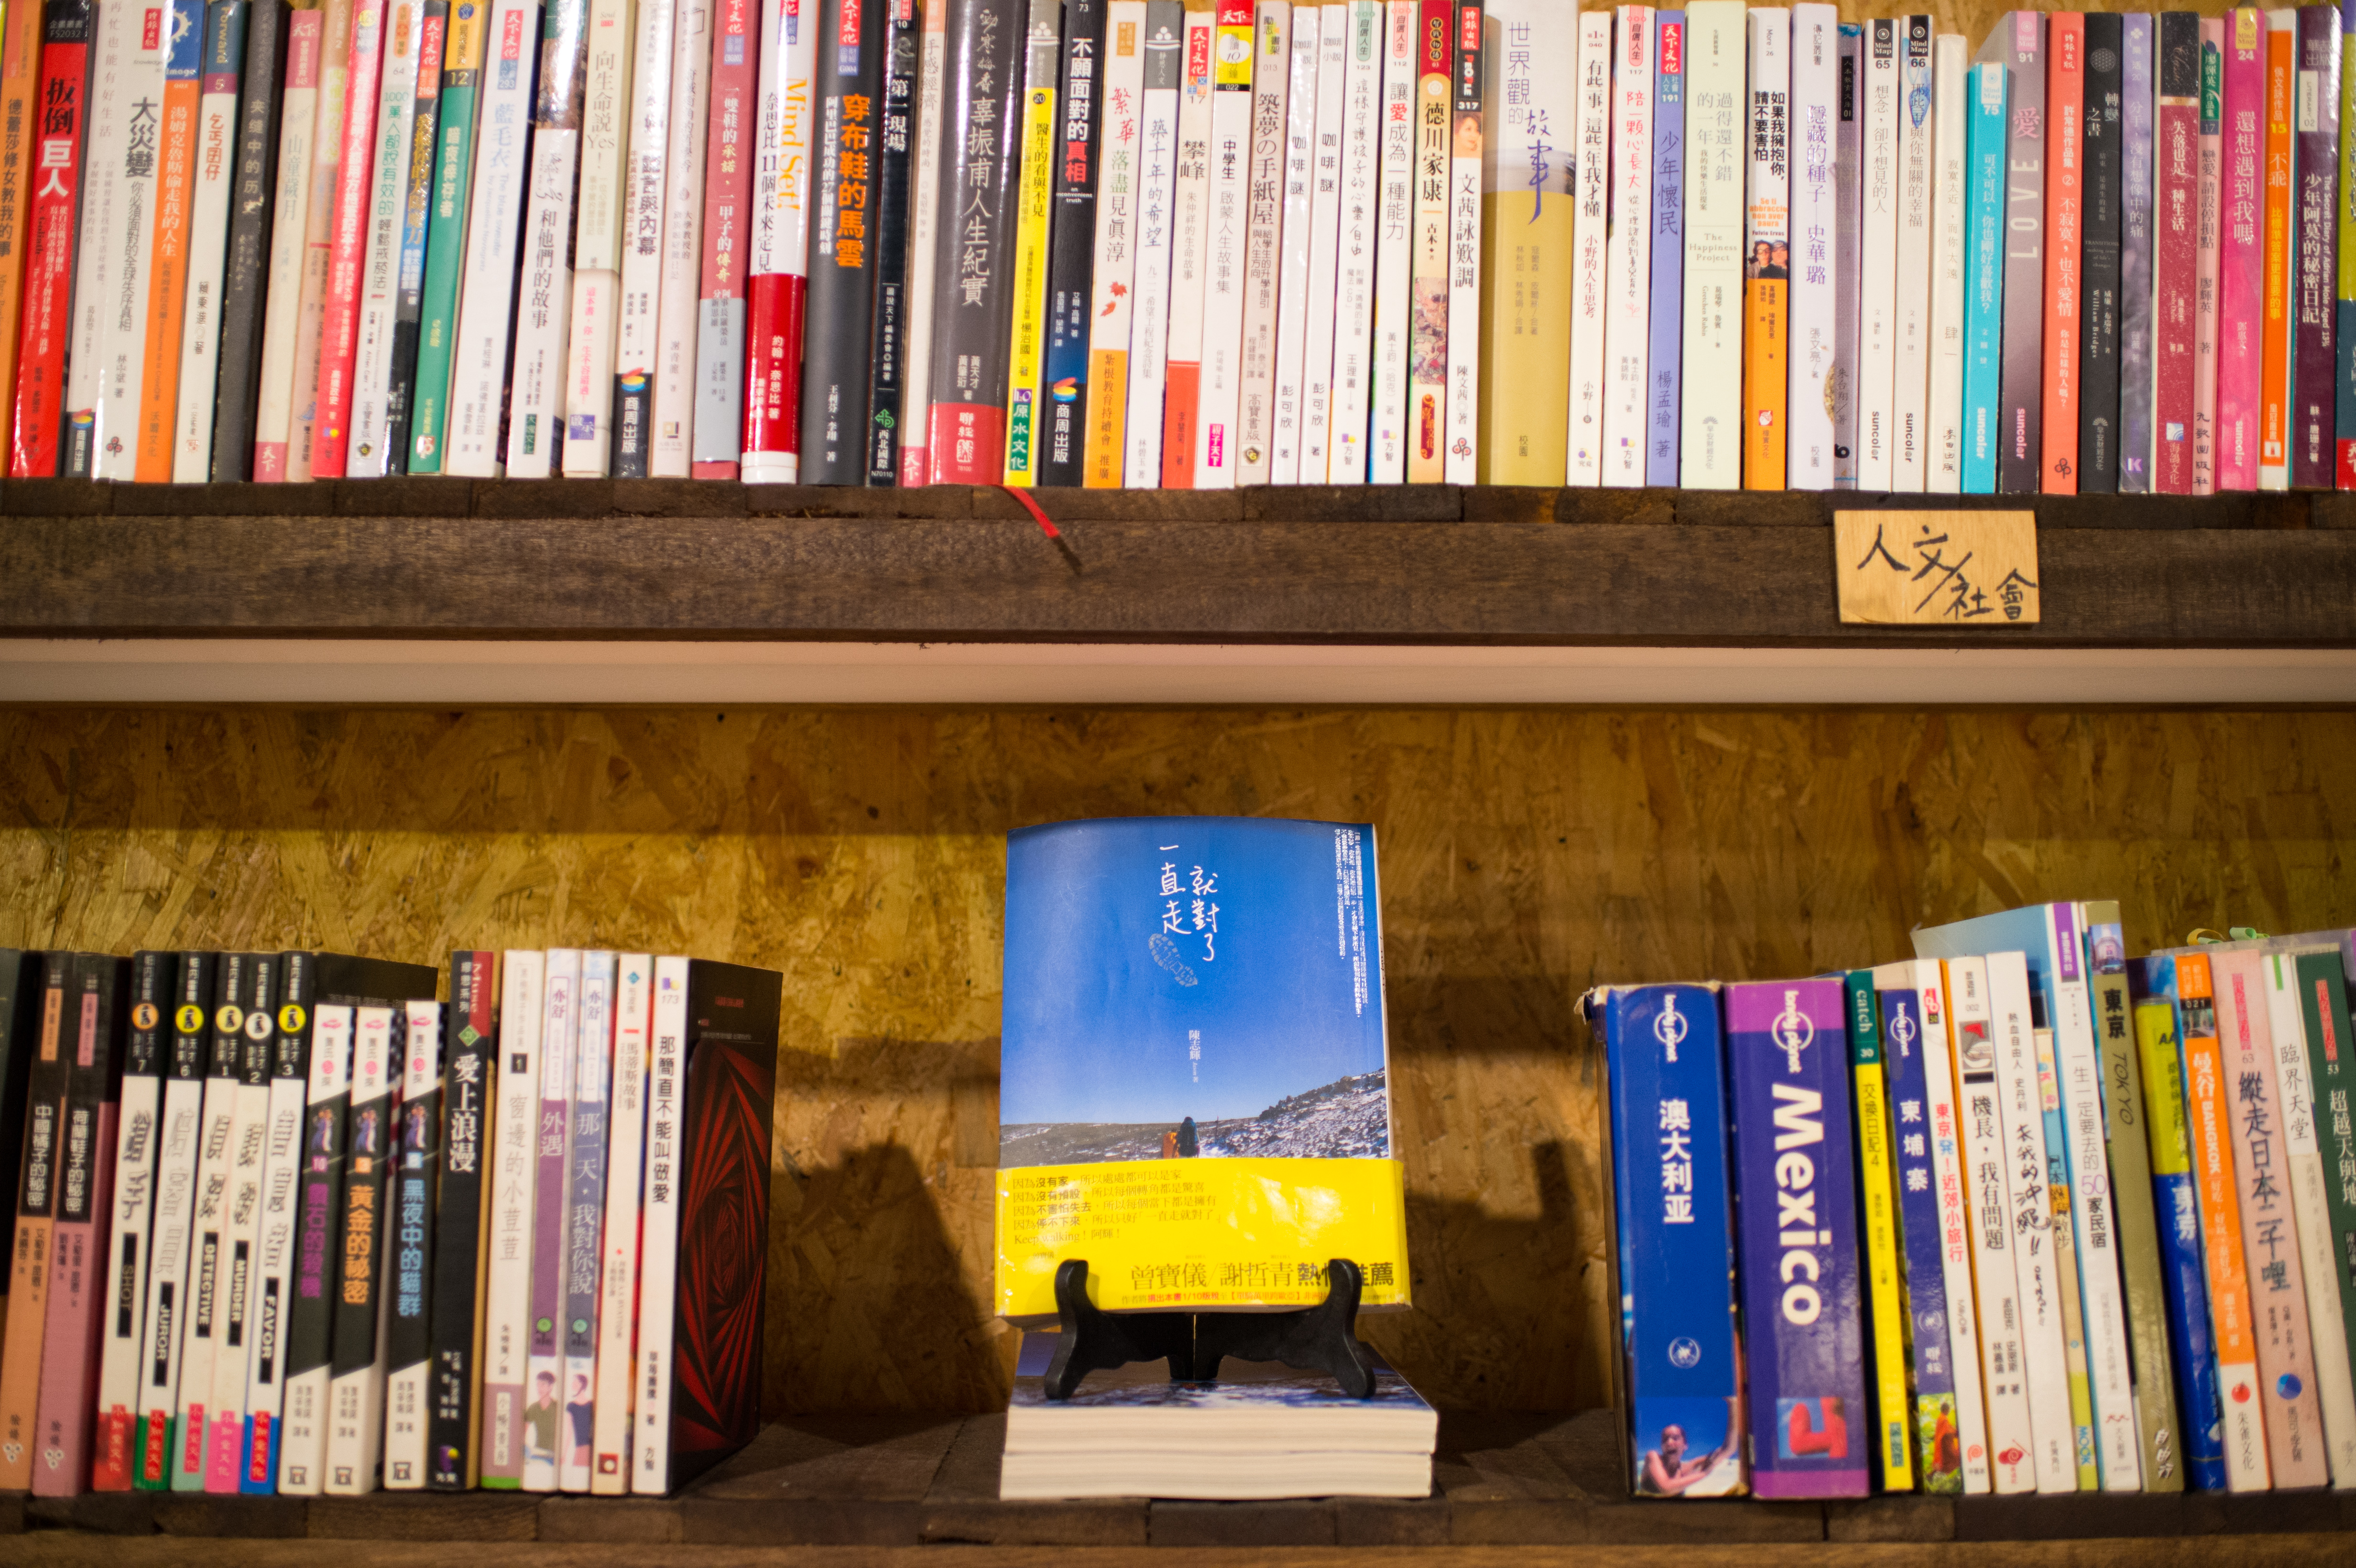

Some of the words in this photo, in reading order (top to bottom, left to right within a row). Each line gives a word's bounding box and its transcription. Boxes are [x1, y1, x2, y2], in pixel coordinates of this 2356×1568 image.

[216, 7, 231, 64] Forward
[424, 21, 440, 65] 天下文化
[502, 12, 521, 58] 天下文化
[1191, 28, 1207, 75] 天下文化
[1359, 19, 1370, 56] 自信人生
[1396, 15, 1406, 51] 自信人生
[1464, 11, 1477, 48] 時報出版
[1631, 24, 1641, 60] 自信人生
[1663, 25, 1680, 73] 天下文化
[921, 39, 939, 111] 手感經濟
[1463, 54, 1475, 96] PEOPLE
[781, 77, 807, 147] Mind
[887, 79, 908, 152] 第一現場
[1065, 38, 1093, 183] 不願面對的真相
[1697, 92, 1714, 144] 的一年
[1754, 91, 1769, 161] 請不要害怕
[2013, 107, 2040, 139] 愛
[125, 97, 158, 178] 大災變
[205, 113, 224, 180] 乞丐囝仔
[490, 104, 515, 168] 藍毛衣
[1180, 140, 1206, 180] 攀峰
[1252, 93, 1280, 225] 築夢の手紙屋
[1386, 82, 1408, 240] 讓愛成為一種能力
[1422, 102, 1445, 201] 德川家康
[1626, 91, 1646, 189] 陪一顆心長大
[1715, 93, 1733, 181] 過得還不錯
[1807, 106, 1827, 203] 隱藏的種子
[2063, 106, 2075, 168] 許常德作品集
[161, 107, 188, 257] 湯姆克魯斯偷走我的人生
[282, 134, 303, 220] 山童歲月
[776, 154, 805, 210] Set!
[836, 94, 871, 268] 穿布鞋的馬雲
[1033, 123, 1050, 217] 醫生的看與不見
[1290, 136, 1307, 195] 咖啡謎
[1320, 134, 1337, 192] 咖啡謎
[1658, 131, 1680, 235] 少年懷民
[2171, 121, 2186, 230] 失落也是一種生活
[2234, 111, 2257, 245] 還想遇到我嗎
[2268, 153, 2287, 187] 不乖
[2324, 176, 2332, 186] The
[960, 97, 996, 307] 辜振甫人生紀實
[2010, 160, 2039, 258] LOVE
[2323, 193, 2332, 218] Secret
[119, 181, 144, 331] 你必須面對的全球失序真相
[1689, 243, 1737, 252] Happiness
[2302, 174, 2322, 324] 少年阿莫的秘密日記
[2322, 221, 2332, 241] Diary
[2324, 245, 2331, 254] of
[1583, 235, 1597, 319] 小野的人生思考
[1696, 254, 1730, 262] Project
[2323, 257, 2332, 283] Adrian
[2199, 277, 2212, 313] 廖輝英
[2321, 306, 2330, 328] Aged
[2323, 286, 2331, 305] Mole
[2091, 327, 2099, 359] Bridges
[1346, 354, 1357, 388] 王理書
[1245, 393, 1262, 441] 高寶書版
[1280, 385, 1294, 428] 彭可欣
[1311, 383, 1325, 426] 彭可欣
[1656, 370, 1673, 428] 楊孟瑜
[622, 397, 639, 454] 商周出版
[877, 430, 889, 468] 西北國際
[1011, 405, 1028, 469] 原水文化
[1053, 404, 1070, 463] 商周出版
[1211, 425, 1222, 466] 親子天下
[1871, 411, 1881, 461] suncolor
[551, 989, 567, 1020] 亦舒
[587, 990, 602, 1021] 亦舒
[662, 995, 679, 1004] 173
[1782, 990, 1800, 1029] lonely
[1856, 990, 1873, 1033] catch
[2104, 989, 2127, 1039] 東京
[180, 1066, 190, 1077] 6
[282, 1065, 294, 1076] 3
[1783, 1031, 1802, 1073] planet
[2193, 1052, 2216, 1098] 曼谷
[2242, 1053, 2255, 1063] 63
[2327, 1065, 2340, 1075] 53
[250, 1072, 262, 1083] 2
[2113, 1053, 2134, 1125] TOKYO
[2280, 1044, 2309, 1141] 臨界天堂
[448, 1053, 481, 1173] 愛上浪漫
[539, 1113, 565, 1157] 外遇
[652, 1036, 676, 1203] 那簡直不能叫做愛
[2201, 1101, 2222, 1174] BANGKOK
[1771, 1083, 1832, 1326] Mexico
[1014, 1233, 1039, 1245] Keep
[198, 1244, 217, 1325] DETECTIVE
[230, 1260, 247, 1323] MURDER
[1298, 1262, 1394, 1287] 熱推薦
[156, 1305, 171, 1361] JUROR
[262, 1296, 276, 1359] FAVOR
[644, 1448, 656, 1470] 方智
[2078, 1426, 2092, 1465] MOOK
